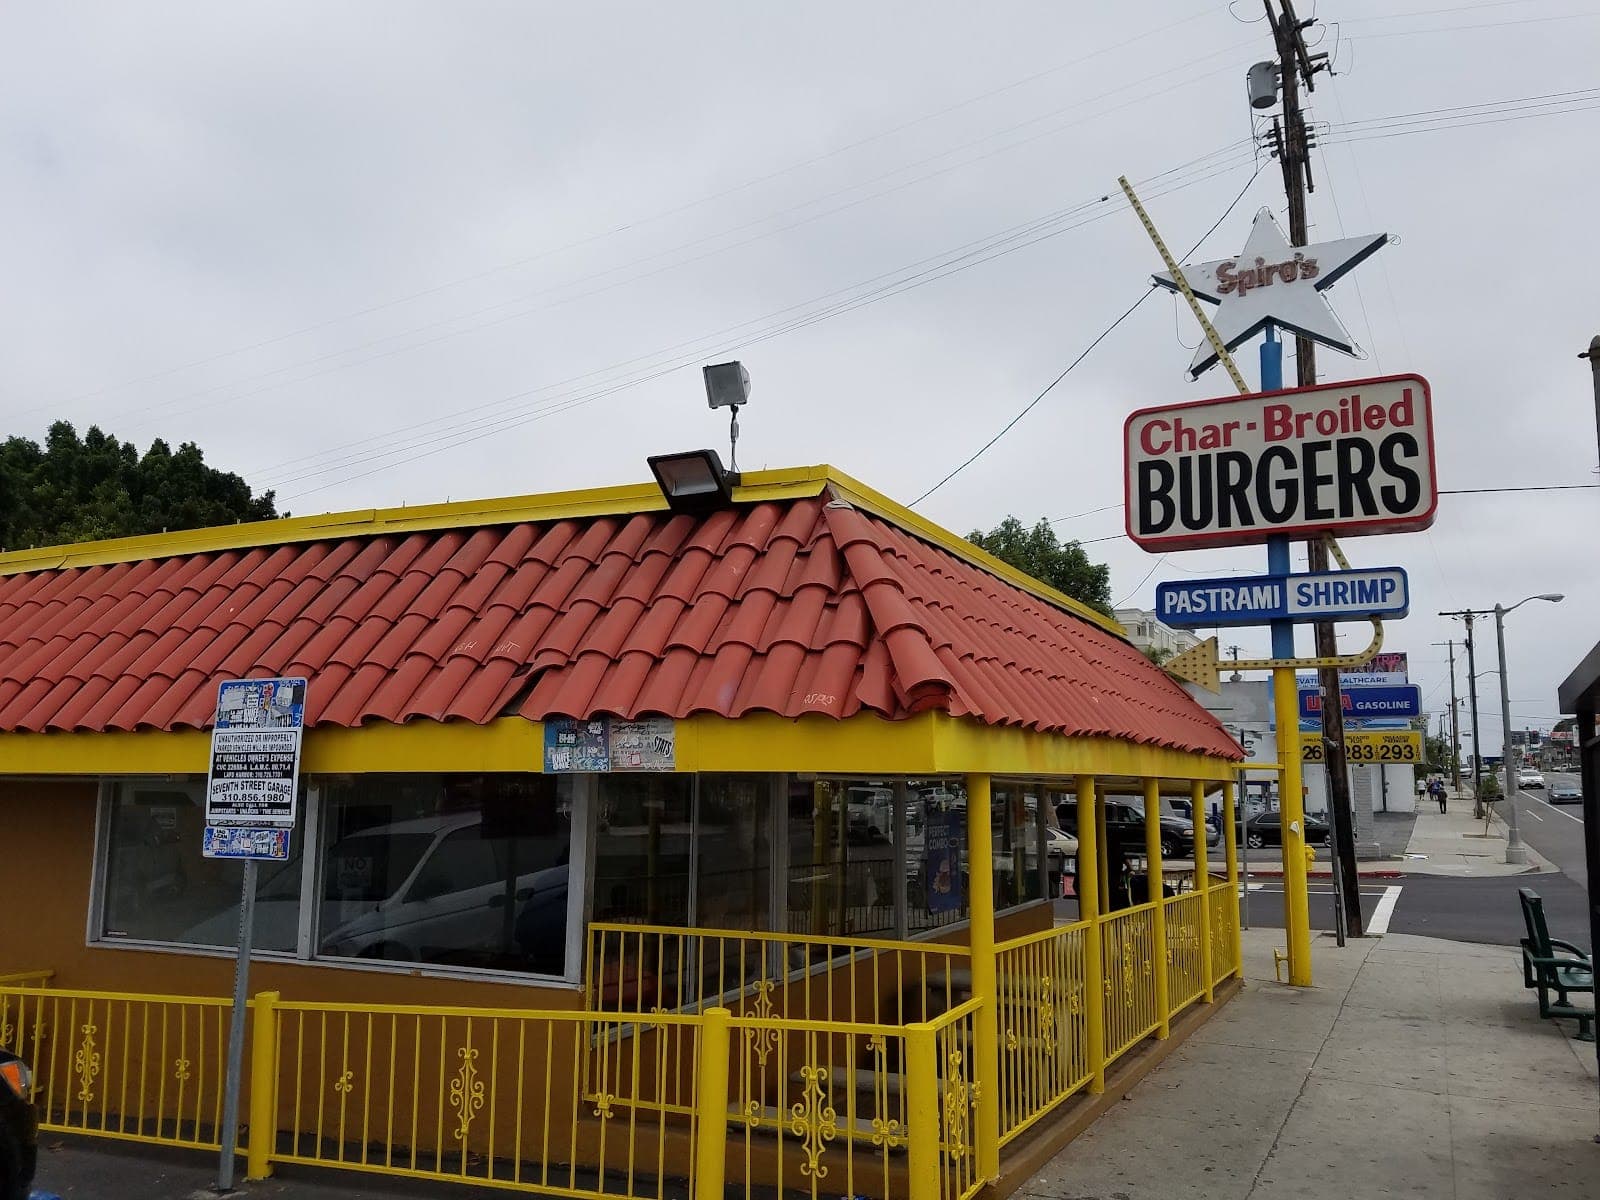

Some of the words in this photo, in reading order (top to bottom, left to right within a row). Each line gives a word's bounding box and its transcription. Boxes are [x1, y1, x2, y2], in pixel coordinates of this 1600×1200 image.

[1216, 251, 1320, 297] Spiro's
[1138, 432, 1421, 535] BURGERS
[1164, 584, 1281, 614] PASTRAMI
[1296, 578, 1397, 607] SHRIMP
[1306, 694, 1353, 711] UA
[1356, 701, 1411, 710] GASOLINE
[218, 735, 254, 743] UNAUTHORIZED
[262, 733, 293, 742] IMPROPERLY
[215, 754, 222, 762] AT
[270, 753, 294, 762] EXPENSE
[1302, 745, 1323, 760] 26
[1380, 744, 1414, 760] 293
[212, 781, 239, 795] SEVENTH
[240, 780, 266, 791] STREET
[267, 782, 291, 796] GARAGE
[221, 793, 285, 802] 310.856.1980
